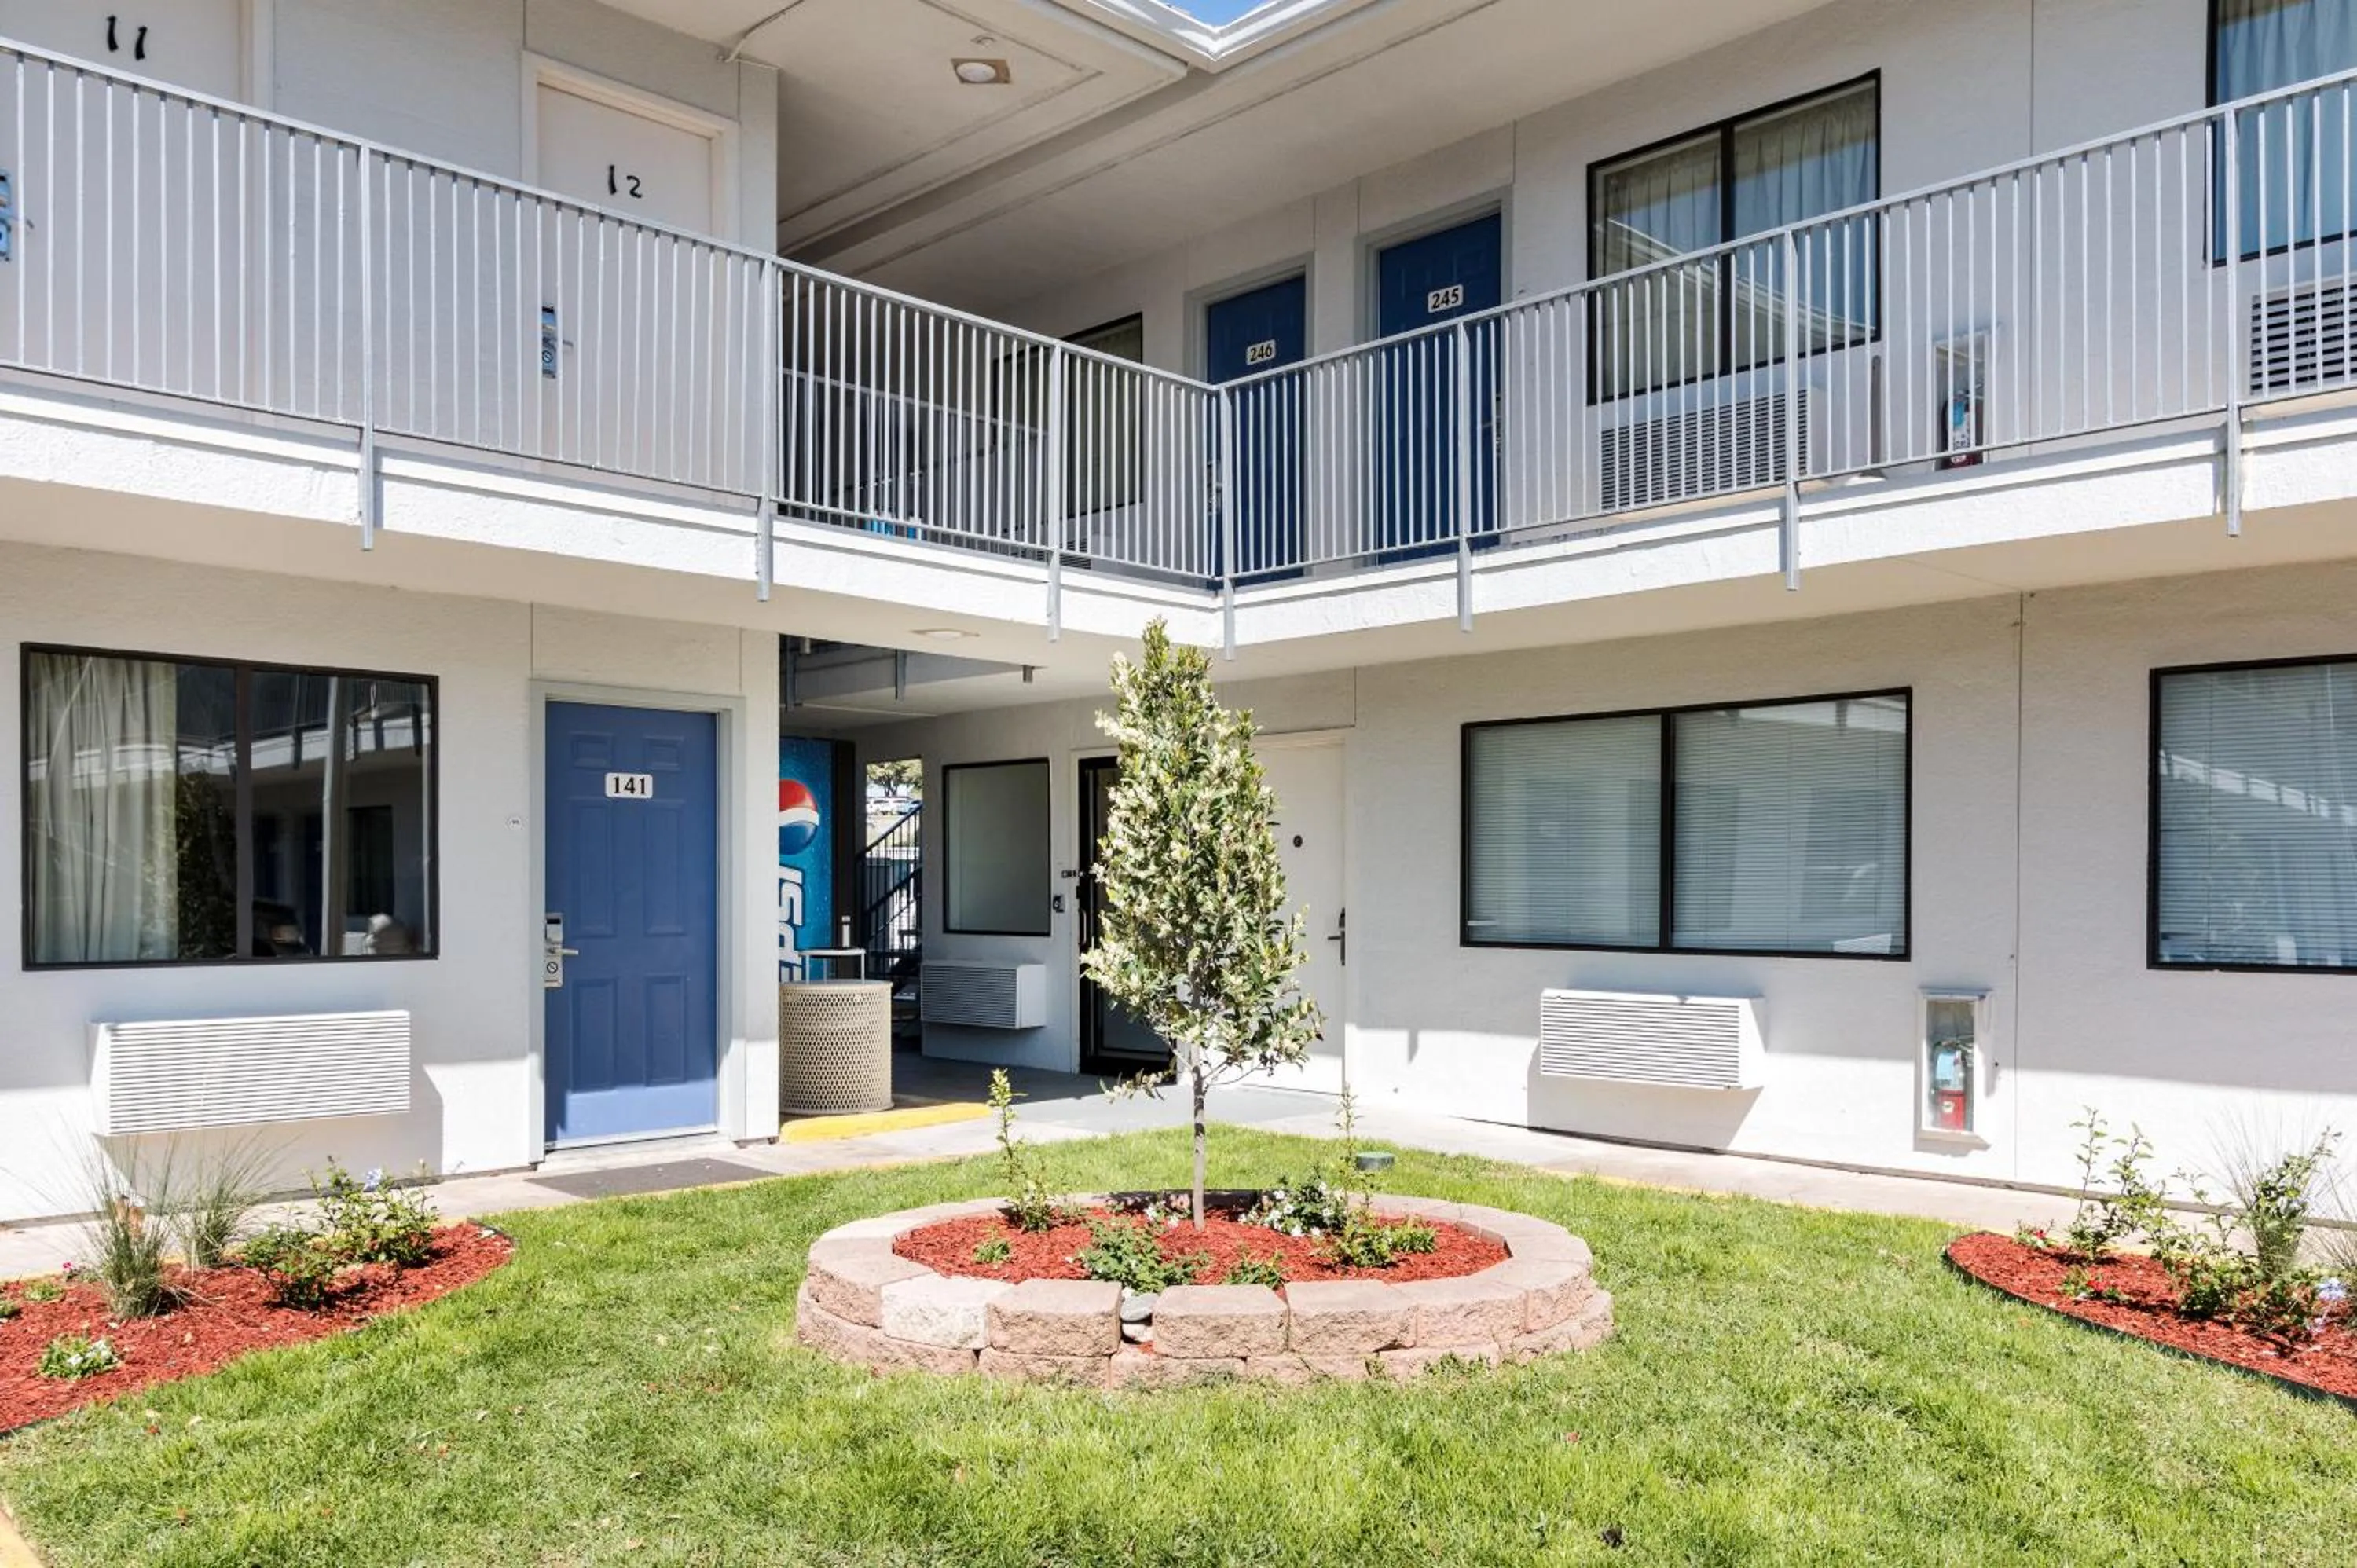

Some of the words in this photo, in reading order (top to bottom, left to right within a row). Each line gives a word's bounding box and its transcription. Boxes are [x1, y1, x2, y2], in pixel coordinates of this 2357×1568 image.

[106, 14, 148, 60] 11
[608, 164, 642, 199] 12
[1432, 288, 1459, 309] 245
[1250, 343, 1272, 361] 246
[614, 776, 645, 795] 141
